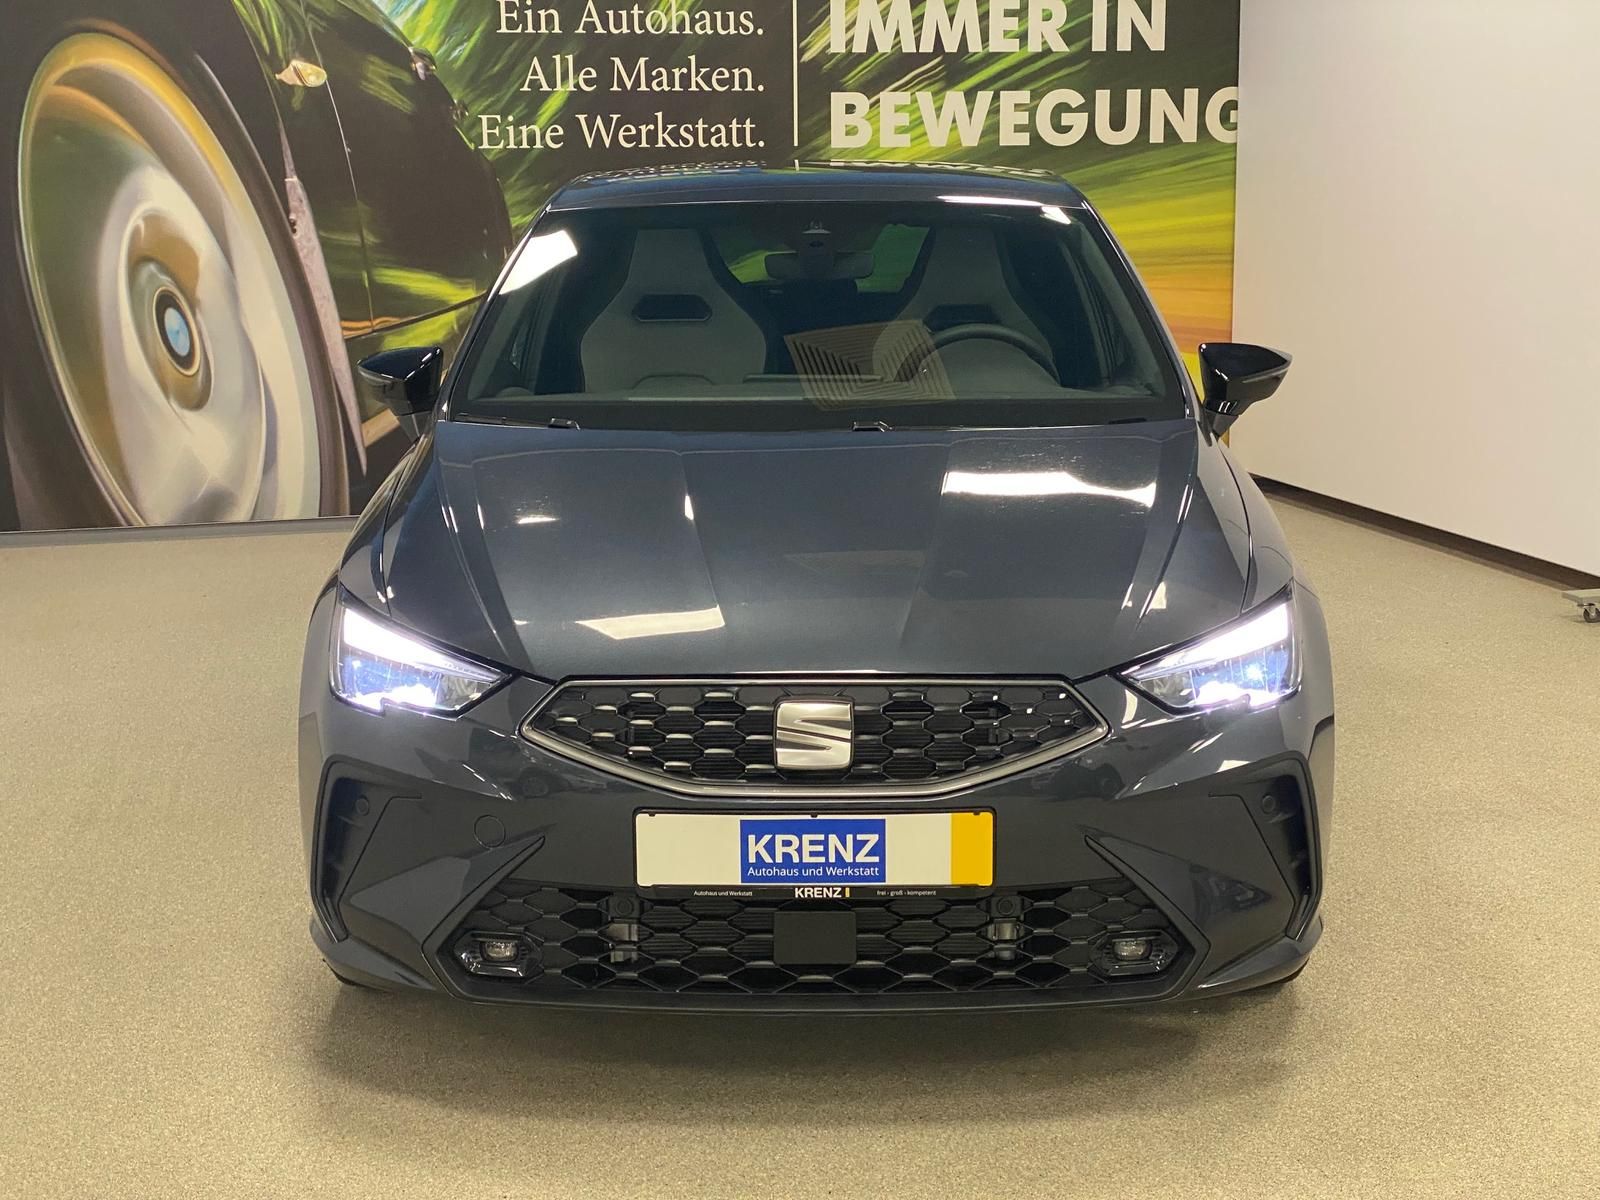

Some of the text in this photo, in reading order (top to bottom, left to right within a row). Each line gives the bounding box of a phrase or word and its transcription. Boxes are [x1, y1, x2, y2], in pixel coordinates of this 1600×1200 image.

[496, 0, 765, 36] Ein Autohaus.
[829, 0, 1167, 53] IMMER IN
[519, 54, 765, 92] Alle Marken.
[477, 111, 765, 149] Eine Werkstatt.
[829, 86, 1239, 149] BEWEGUNG
[747, 833, 880, 863] KRENZ
[747, 866, 880, 877] Autohaus und Werkstatt
[794, 887, 842, 899] KRENZ
